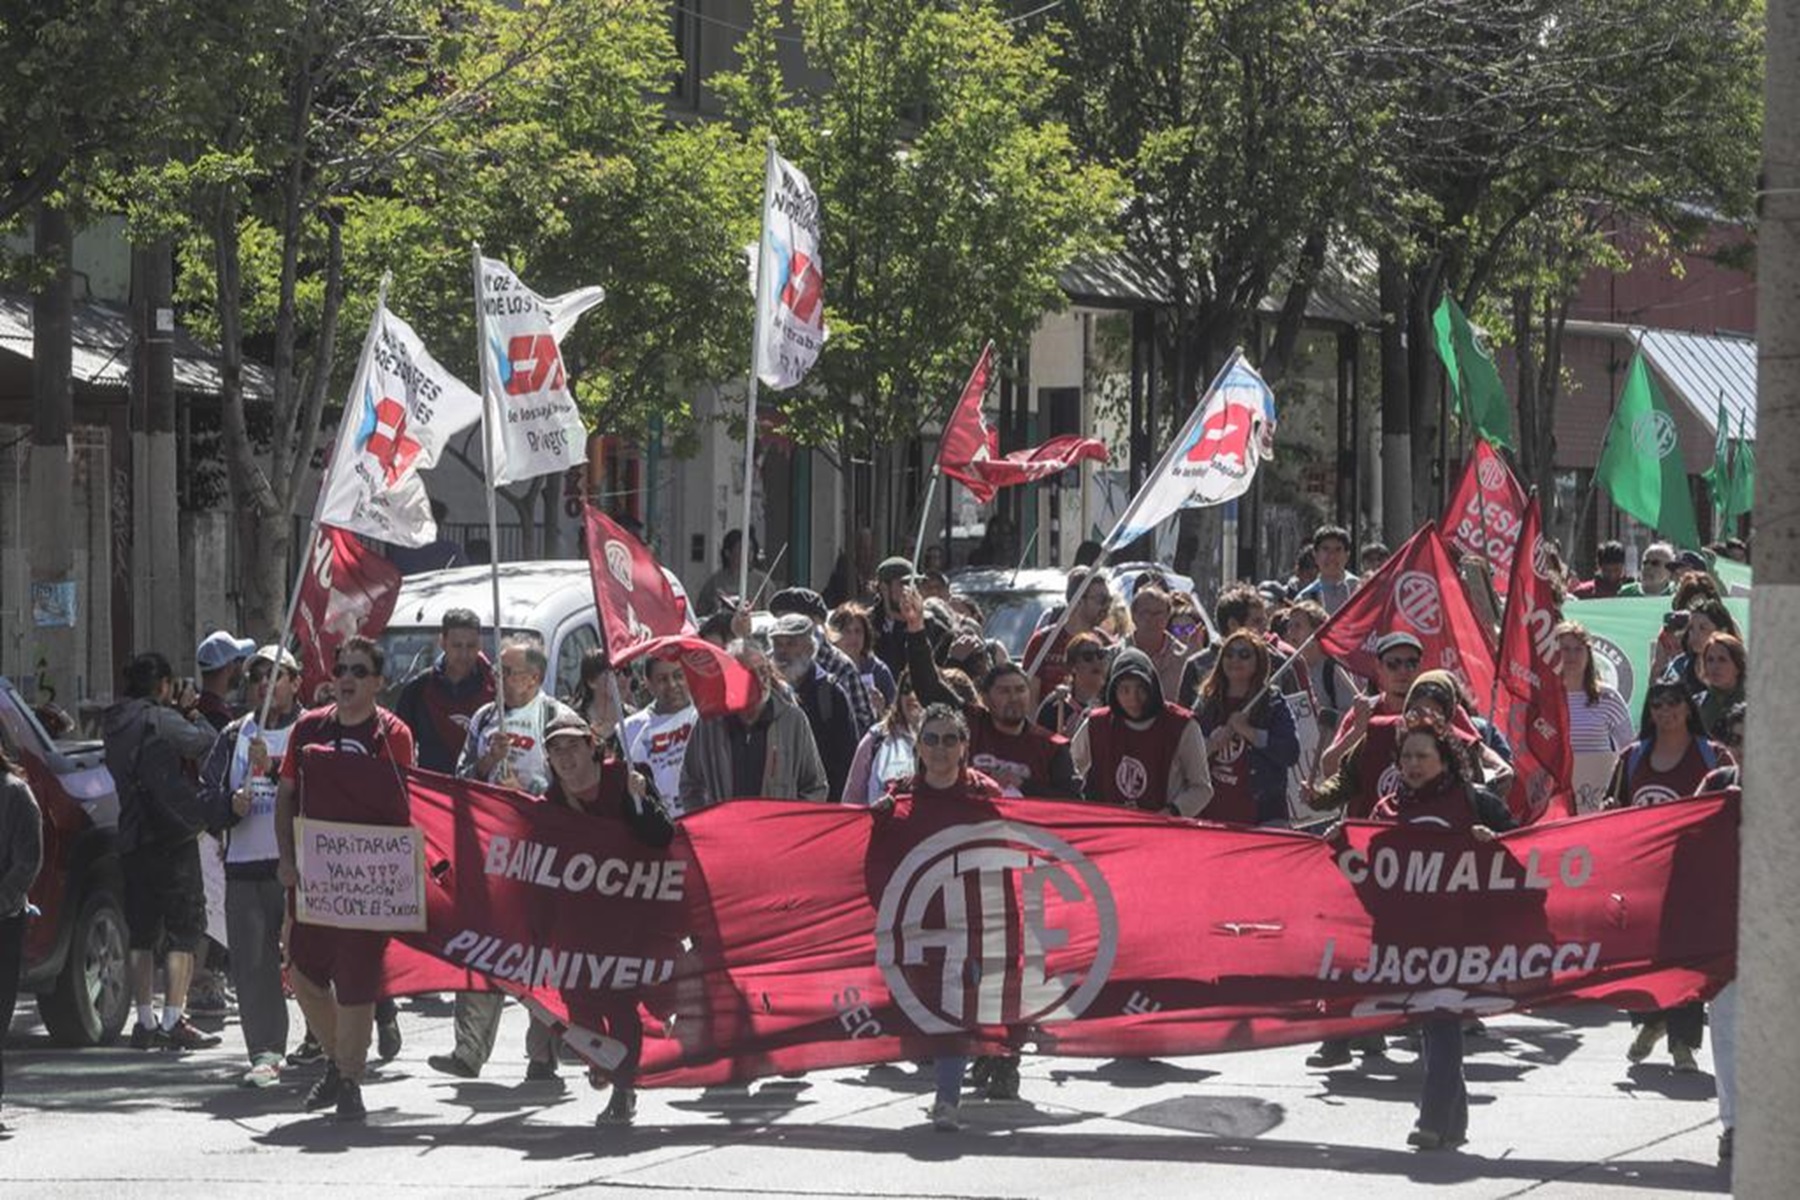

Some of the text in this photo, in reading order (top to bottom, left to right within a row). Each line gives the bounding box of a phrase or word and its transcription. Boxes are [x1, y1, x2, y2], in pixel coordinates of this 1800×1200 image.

[1338, 846, 1593, 893] COMALLO
[444, 929, 674, 990] PILCANIYEU
[898, 843, 1094, 1028] ATE
[1352, 942, 1601, 984] JACOBACCI
